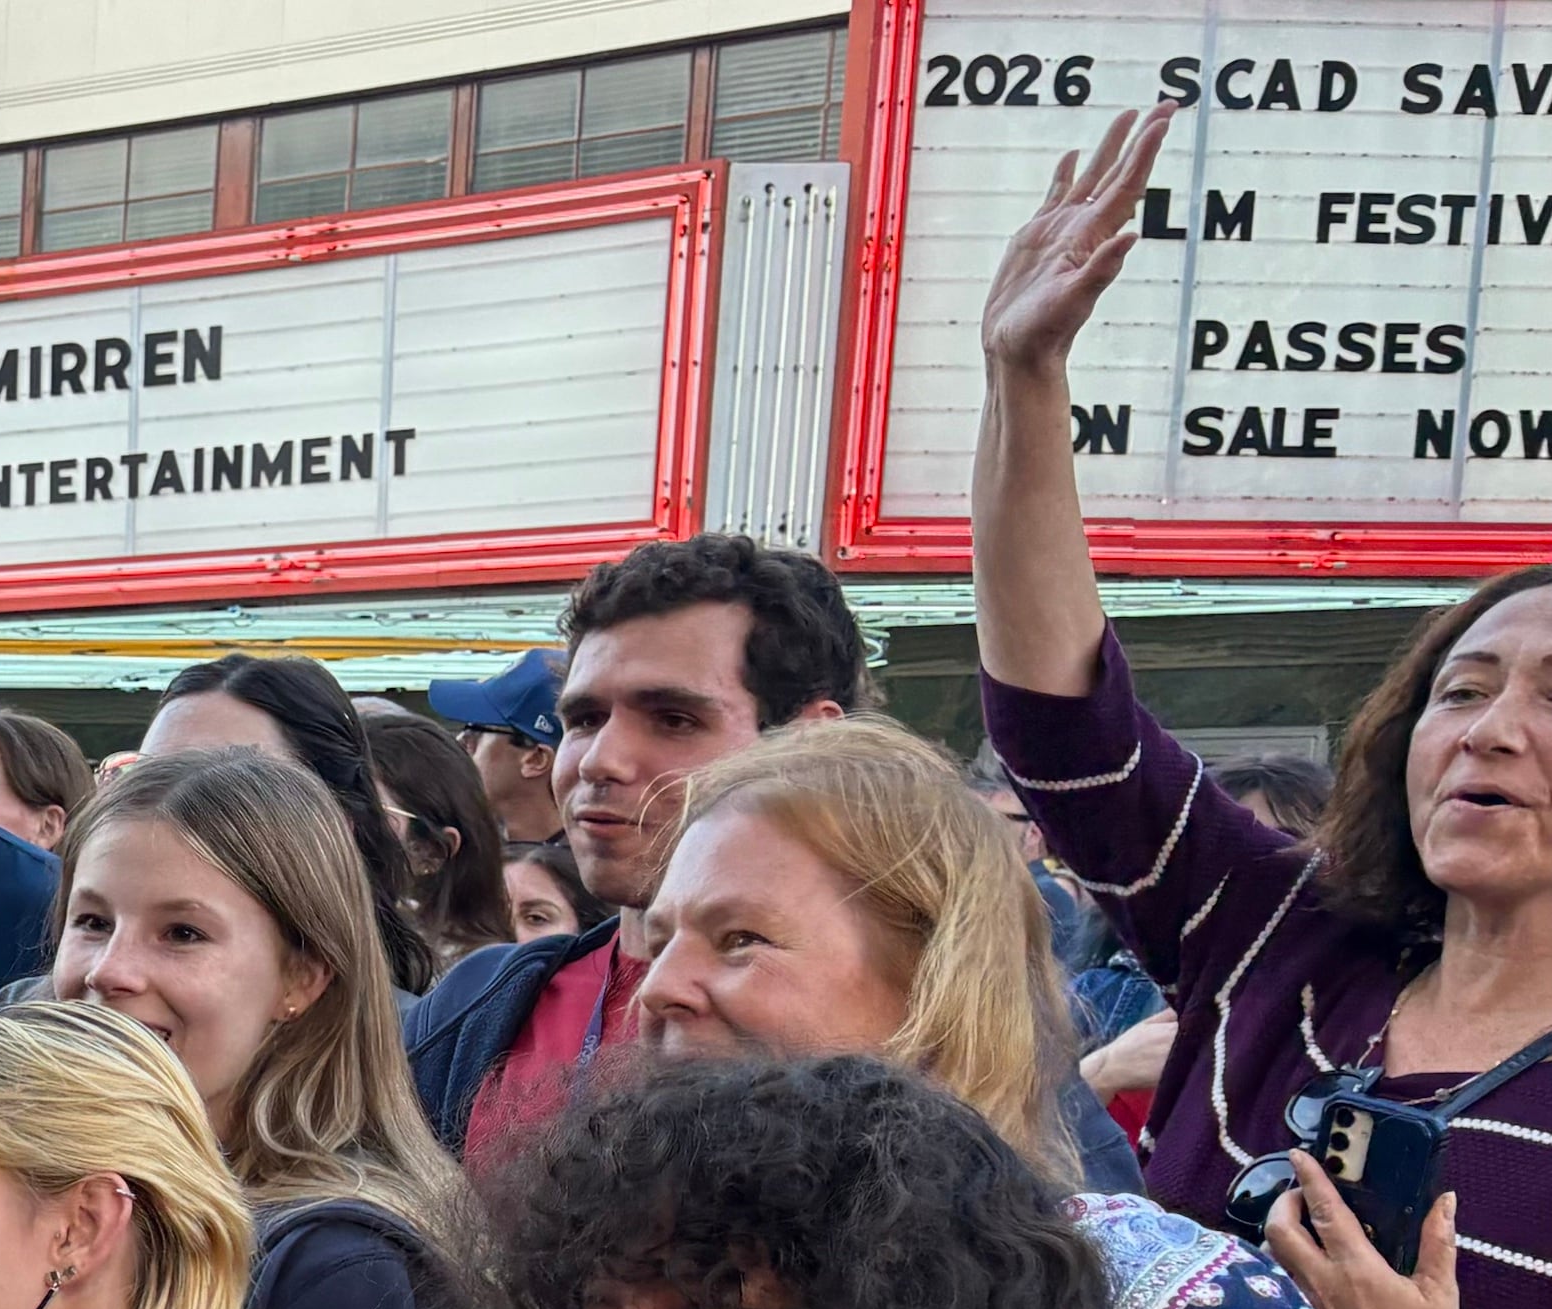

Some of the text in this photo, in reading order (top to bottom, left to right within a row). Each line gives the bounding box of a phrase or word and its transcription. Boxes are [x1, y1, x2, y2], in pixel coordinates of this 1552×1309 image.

[925, 54, 1552, 118] 2026 SCAD SAV
[1139, 188, 1256, 242] LM
[1191, 320, 1467, 375] PASSES
[1182, 406, 1341, 458] SALE
